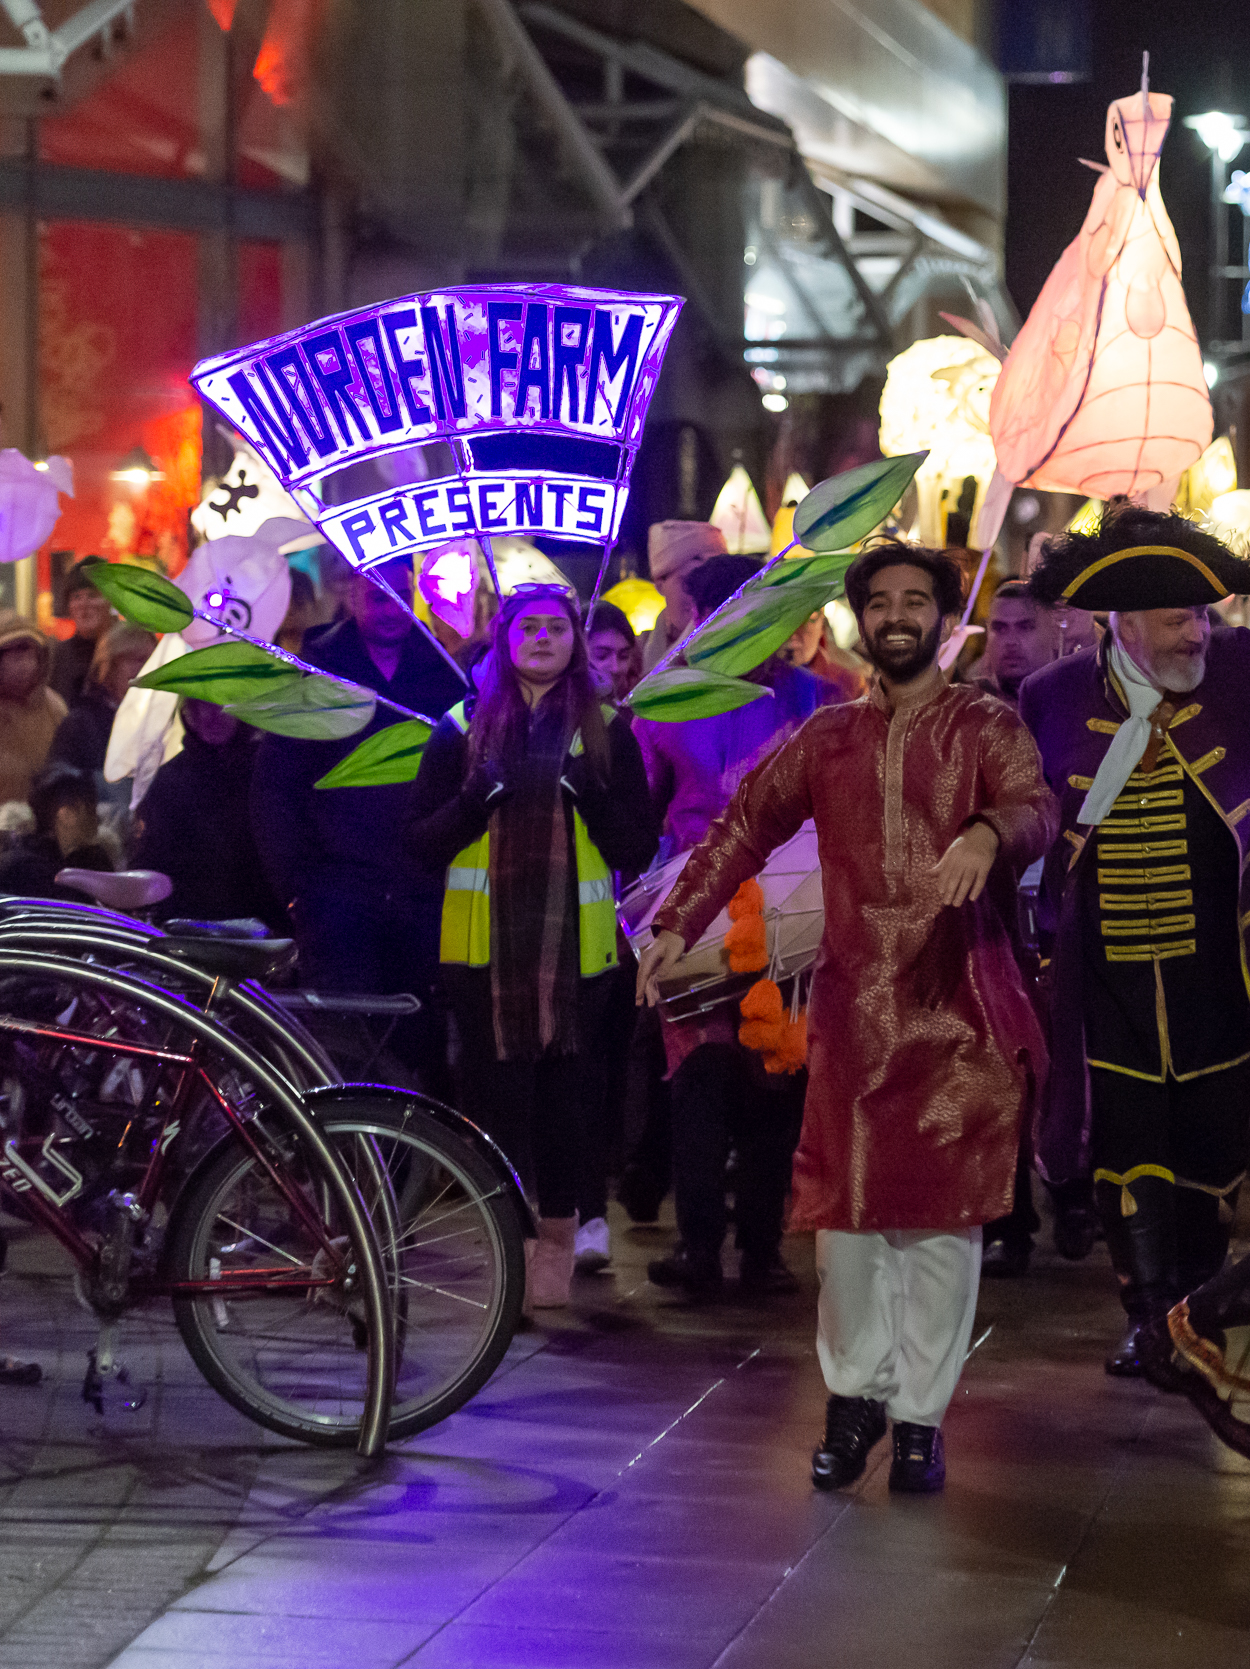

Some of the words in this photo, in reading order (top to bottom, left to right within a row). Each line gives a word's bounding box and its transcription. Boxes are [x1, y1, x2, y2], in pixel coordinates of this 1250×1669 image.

[226, 303, 467, 477] NORDEN
[488, 301, 646, 428] FARM
[340, 483, 607, 561] PRESENTS
